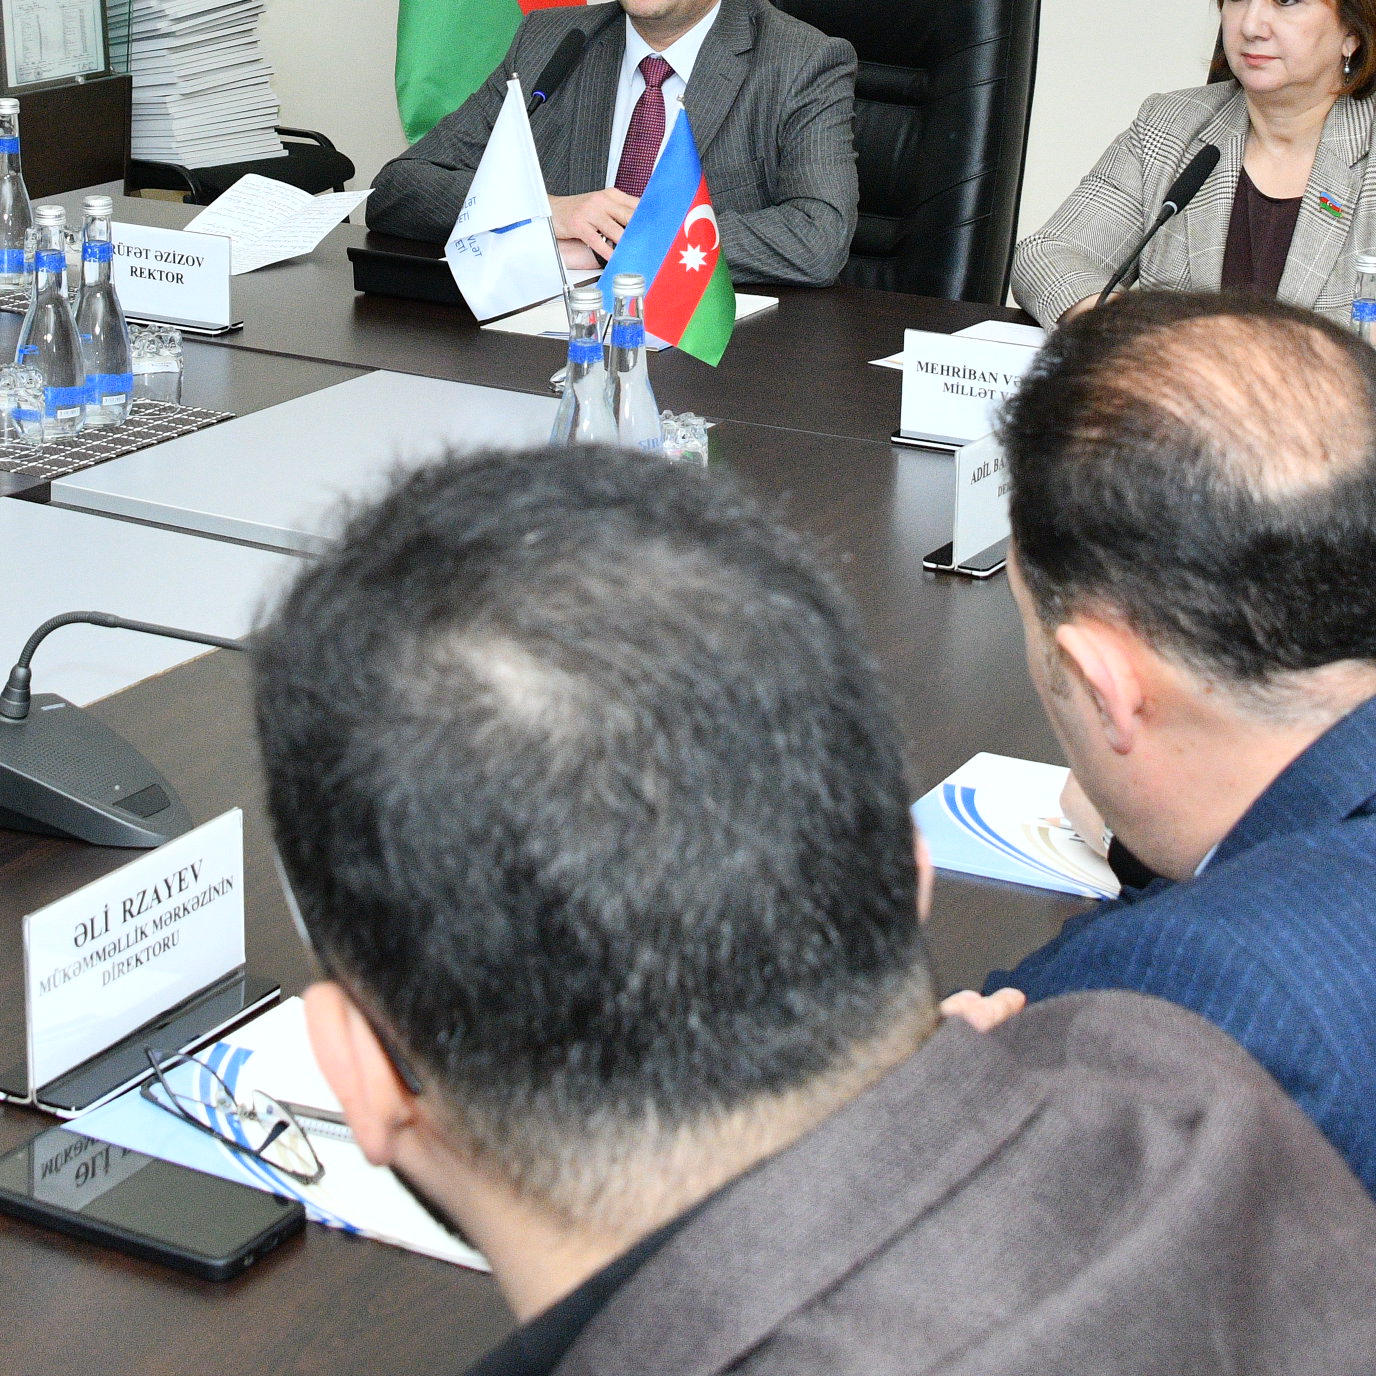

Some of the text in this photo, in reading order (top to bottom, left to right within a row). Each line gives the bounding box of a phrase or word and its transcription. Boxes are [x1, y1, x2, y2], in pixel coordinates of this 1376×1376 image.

[154, 249, 205, 268] ƏZİZOV
[129, 265, 185, 285] REKTOR
[916, 360, 1023, 388] MEHRİBAN VƏ
[942, 381, 997, 401] MİLLƏT
[970, 457, 1005, 485] ADİL BA
[74, 858, 204, 949] ƏLİ RZAYEV
[39, 874, 235, 997] MÜKƏMMƏLLİK MƏRKƏZİNİN
[102, 930, 181, 987] DİREKTORU
